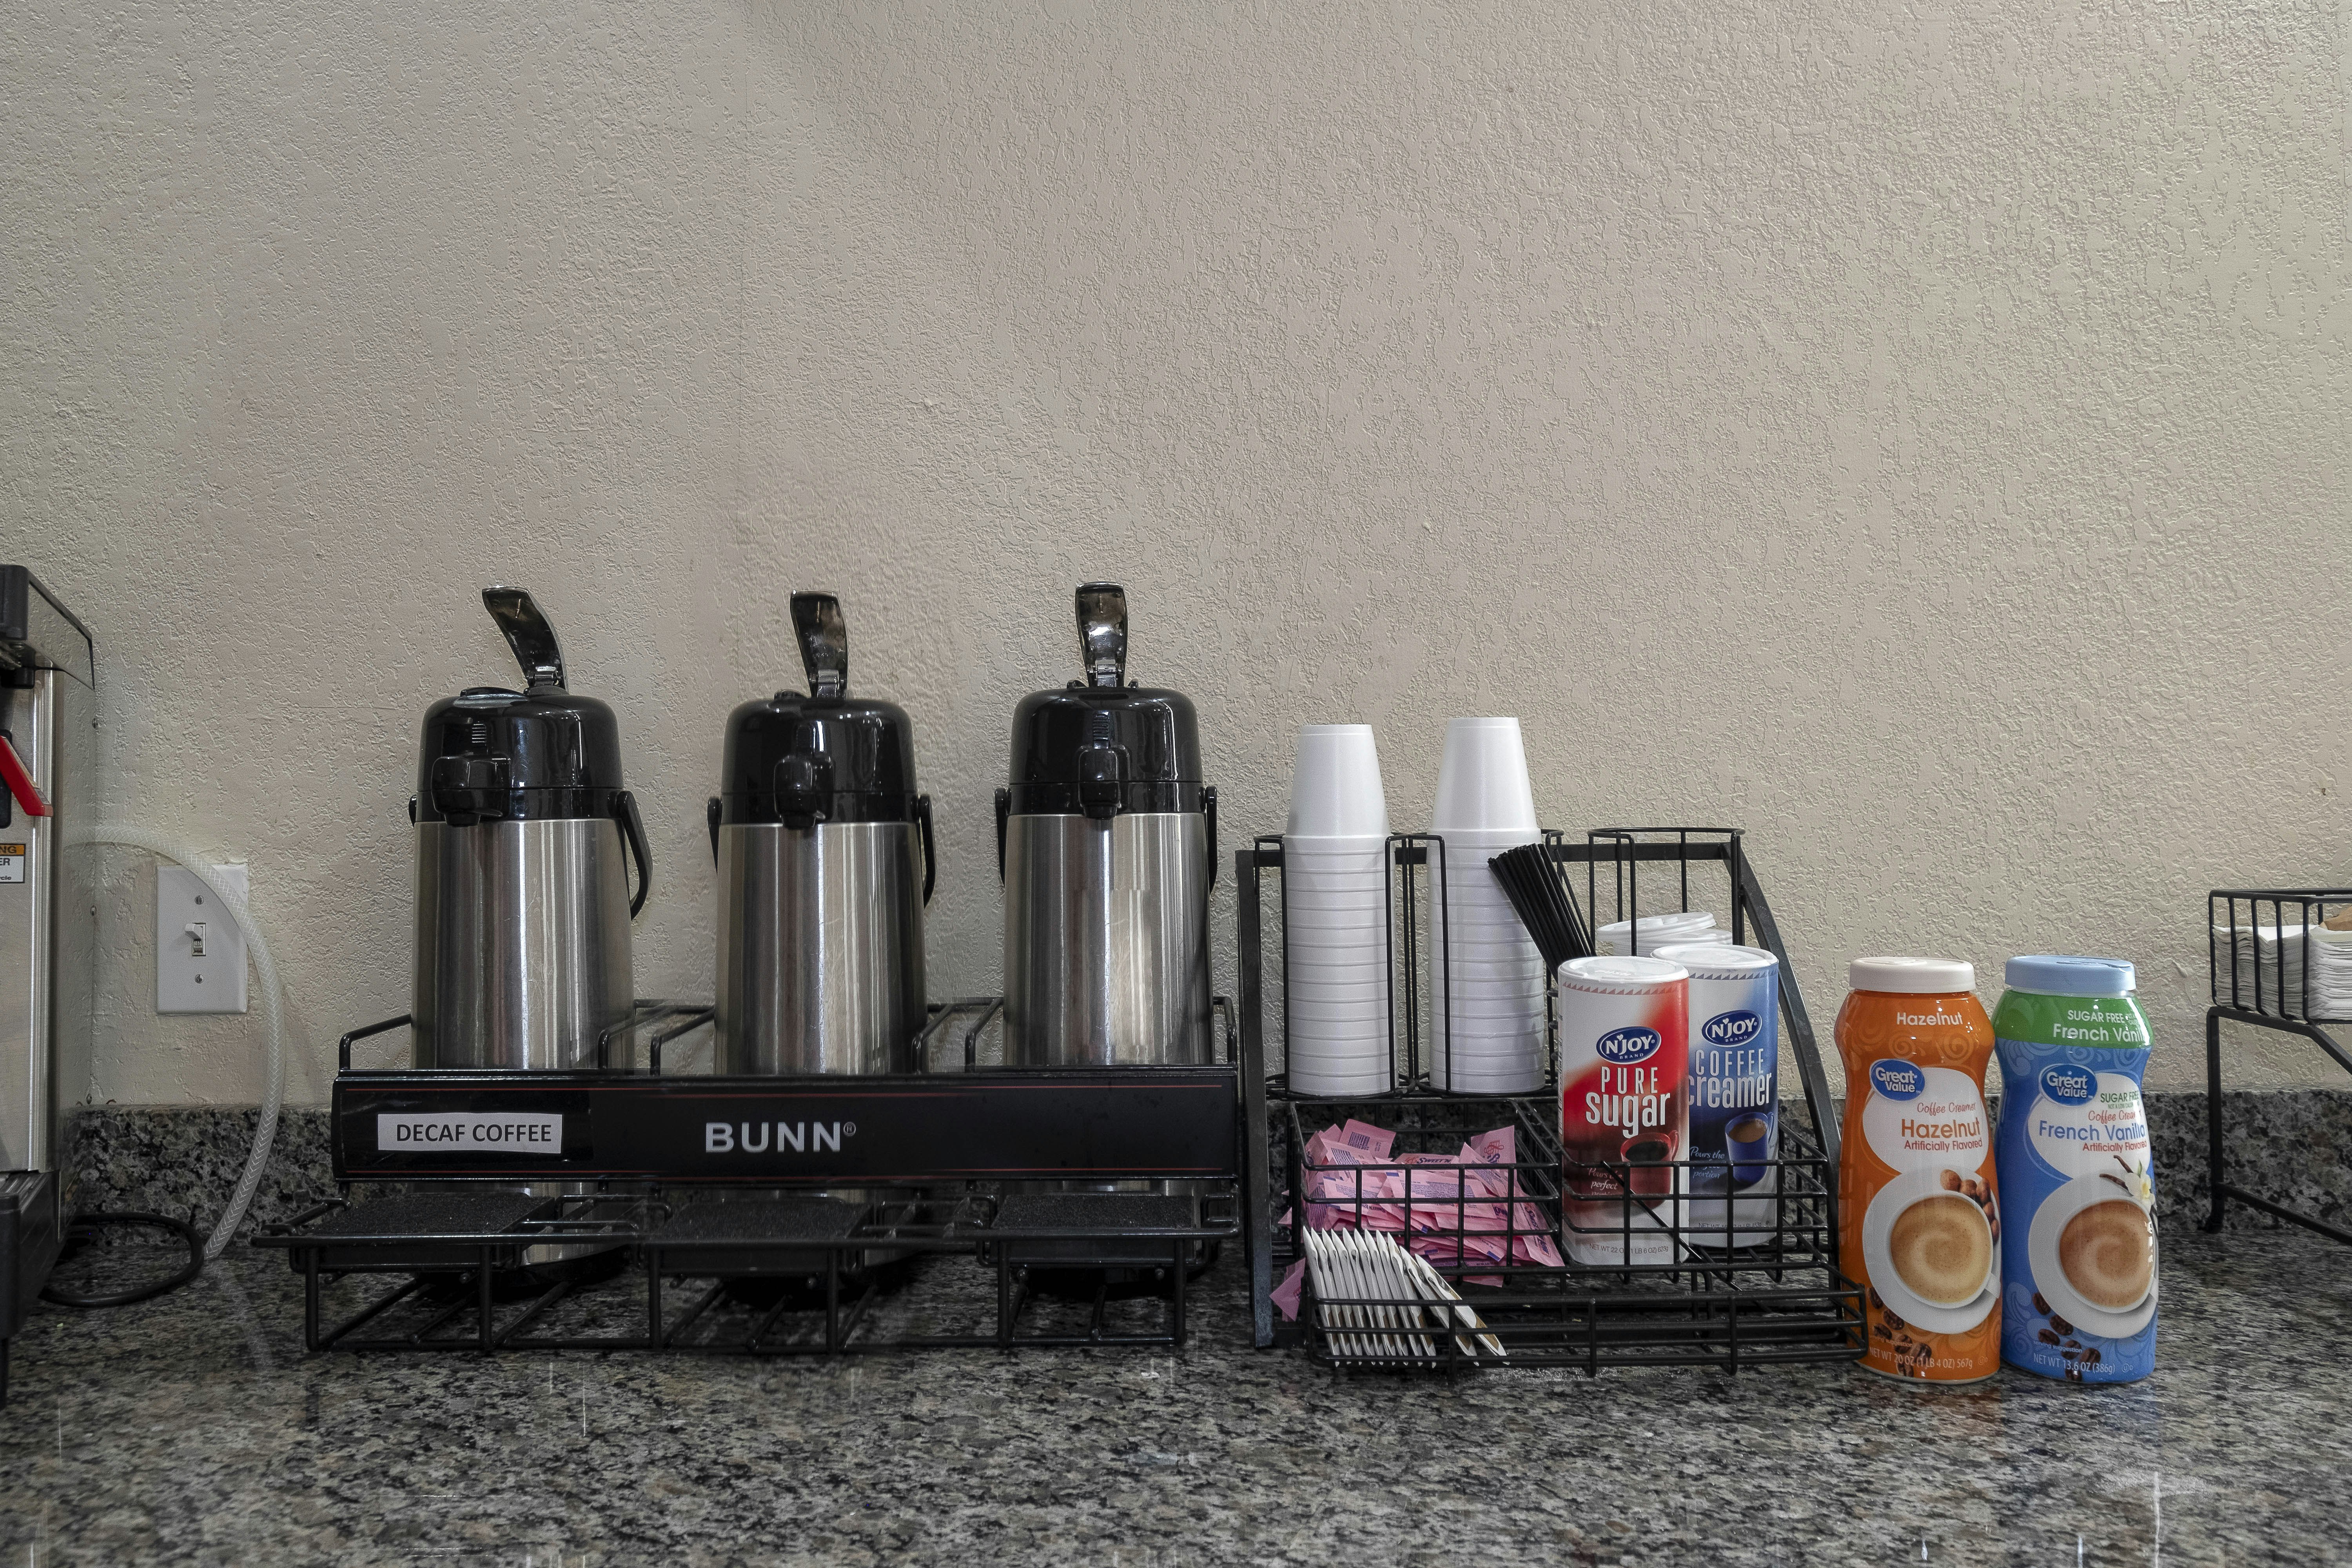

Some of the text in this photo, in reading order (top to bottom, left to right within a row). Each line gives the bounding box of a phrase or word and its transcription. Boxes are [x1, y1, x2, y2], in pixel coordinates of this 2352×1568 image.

[1897, 1012, 1963, 1025] Hazelnut
[2067, 1010, 2104, 1022] SUGAR
[2105, 1013, 2125, 1024] FREE
[2053, 1024, 2109, 1042] French
[1696, 1048, 1764, 1076] COFFEE
[1602, 1066, 1658, 1094] PURE
[1876, 1067, 1915, 1083] Great
[2047, 1072, 2088, 1089] Great
[2101, 1091, 2139, 1103] SUGAR FREE
[1586, 1092, 1670, 1139] sugar
[1917, 1102, 1976, 1116] Coffee Creamer
[2089, 1110, 2116, 1124] Coffee
[397, 1124, 552, 1142] DECAF COFFEE
[1902, 1118, 1980, 1138] Hazelnut
[2040, 1120, 2145, 1141] French Vanilla
[1690, 1147, 1725, 1159] Pours the
[1904, 1138, 1982, 1153] Artificially Flavored
[2083, 1140, 2147, 1153] Artificially Flavored
[1591, 1180, 1618, 1191] perfect
[1869, 1346, 1880, 1358] NET
[1881, 1350, 1892, 1361] WT
[1894, 1354, 1903, 1364] 20
[1905, 1356, 1915, 1366] OZ
[1926, 1357, 1935, 1368] LB
[1936, 1359, 1941, 1368] 4
[1943, 1358, 1955, 1370] OZ)
[1957, 1358, 1973, 1369] 567g
[2034, 1352, 2046, 1364] NET
[2047, 1356, 2060, 1368] WT
[2063, 1360, 2079, 1371] 13.6
[2080, 1361, 2091, 1372] OZ
[2093, 1362, 2115, 1375] (386g)
